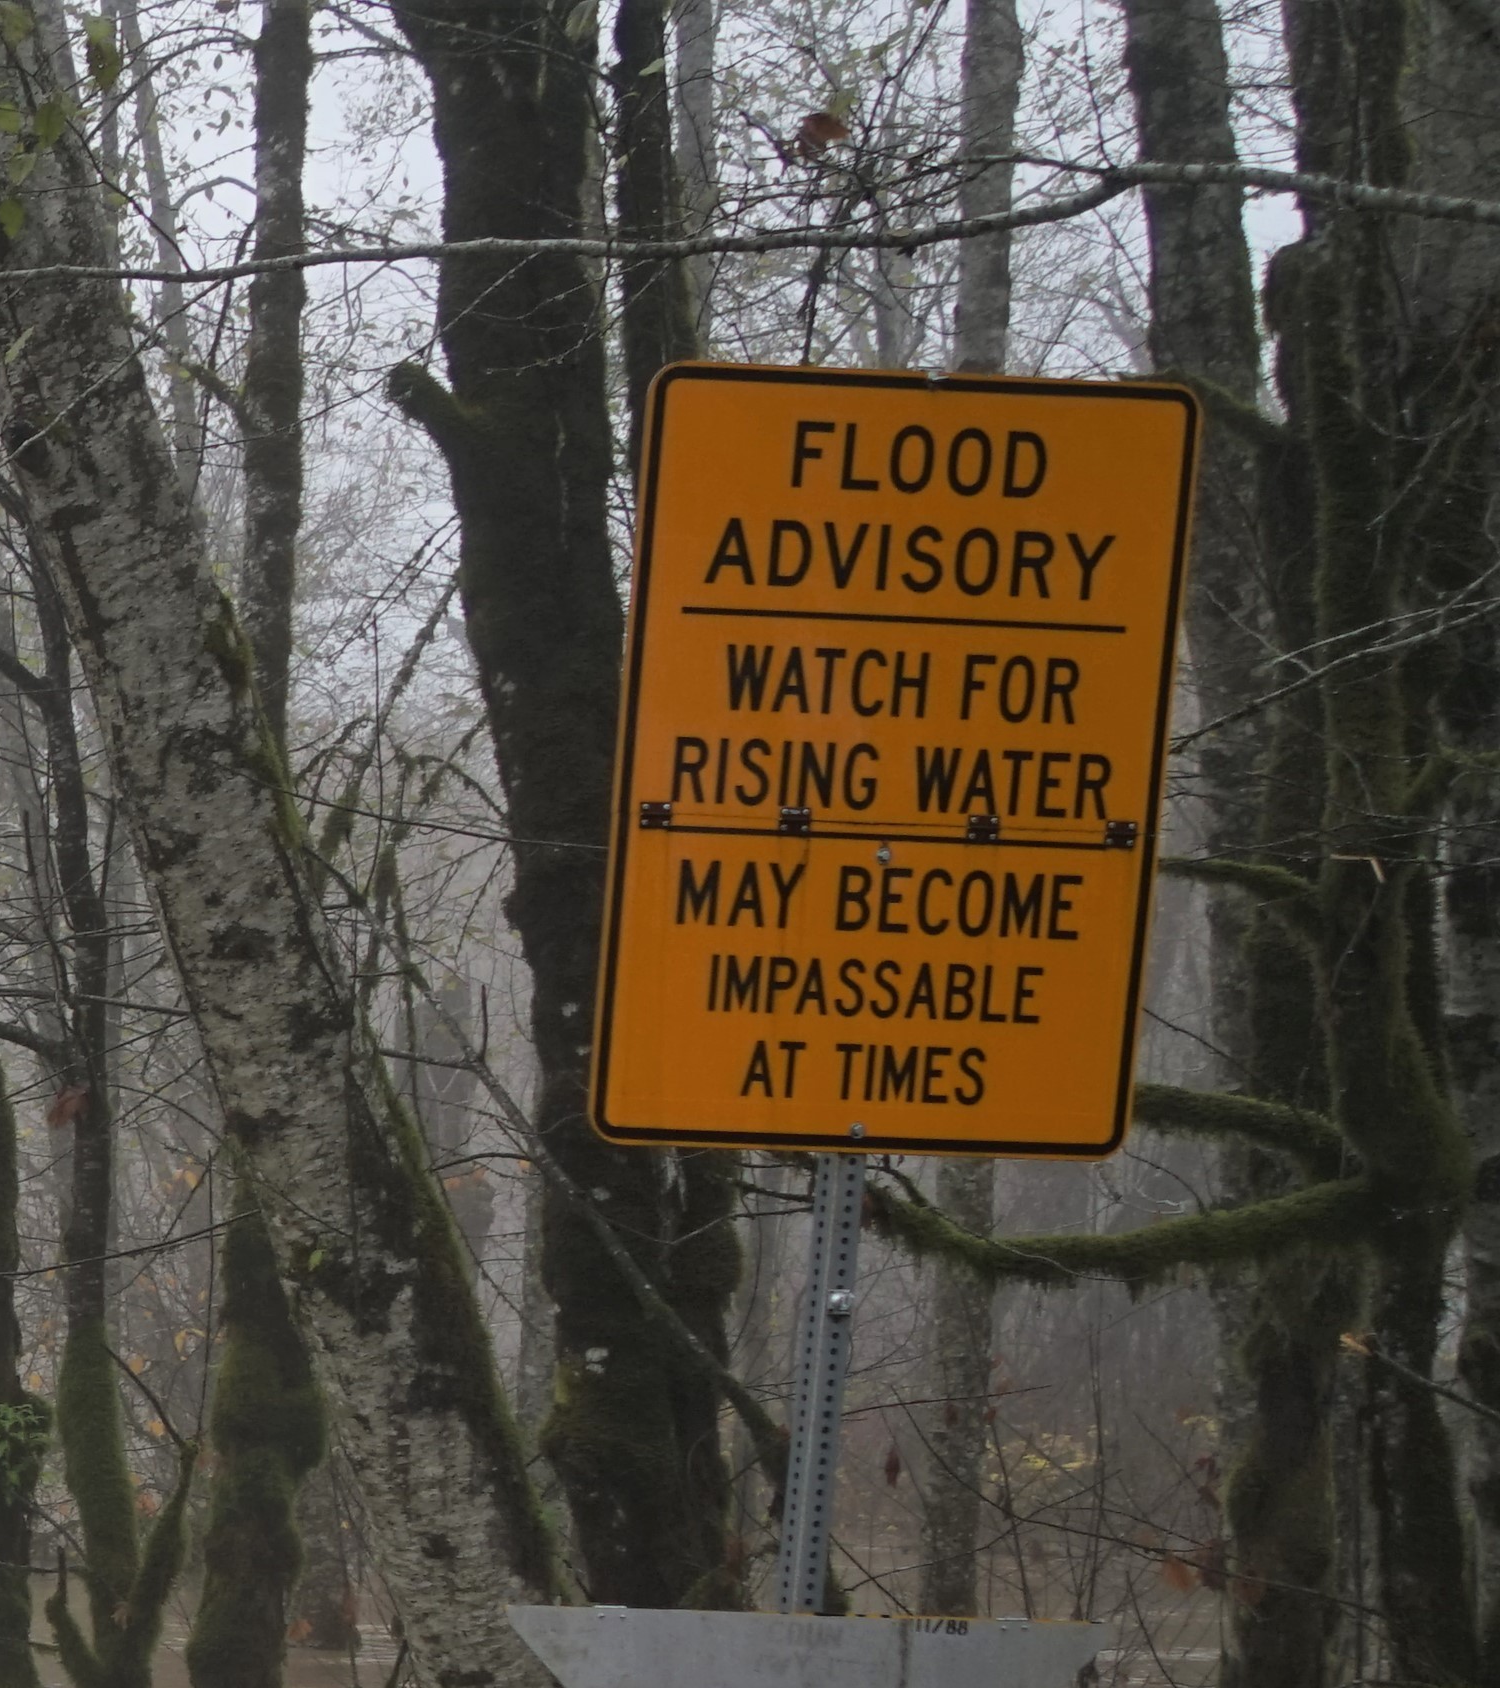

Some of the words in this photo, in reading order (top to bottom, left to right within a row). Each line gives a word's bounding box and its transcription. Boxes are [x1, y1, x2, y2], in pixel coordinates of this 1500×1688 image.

[792, 421, 1047, 498] FLOOD
[705, 518, 1116, 600] ADVISORY
[728, 644, 930, 718] WATCH
[961, 654, 1080, 724] FOR
[671, 736, 880, 810] RISING
[915, 747, 1112, 821] WATER
[676, 859, 806, 928] MAY
[836, 866, 1083, 940] BECOME
[708, 955, 1044, 1024] IMPASSABLE
[741, 1040, 806, 1098] AT
[836, 1044, 986, 1105] TIMES
